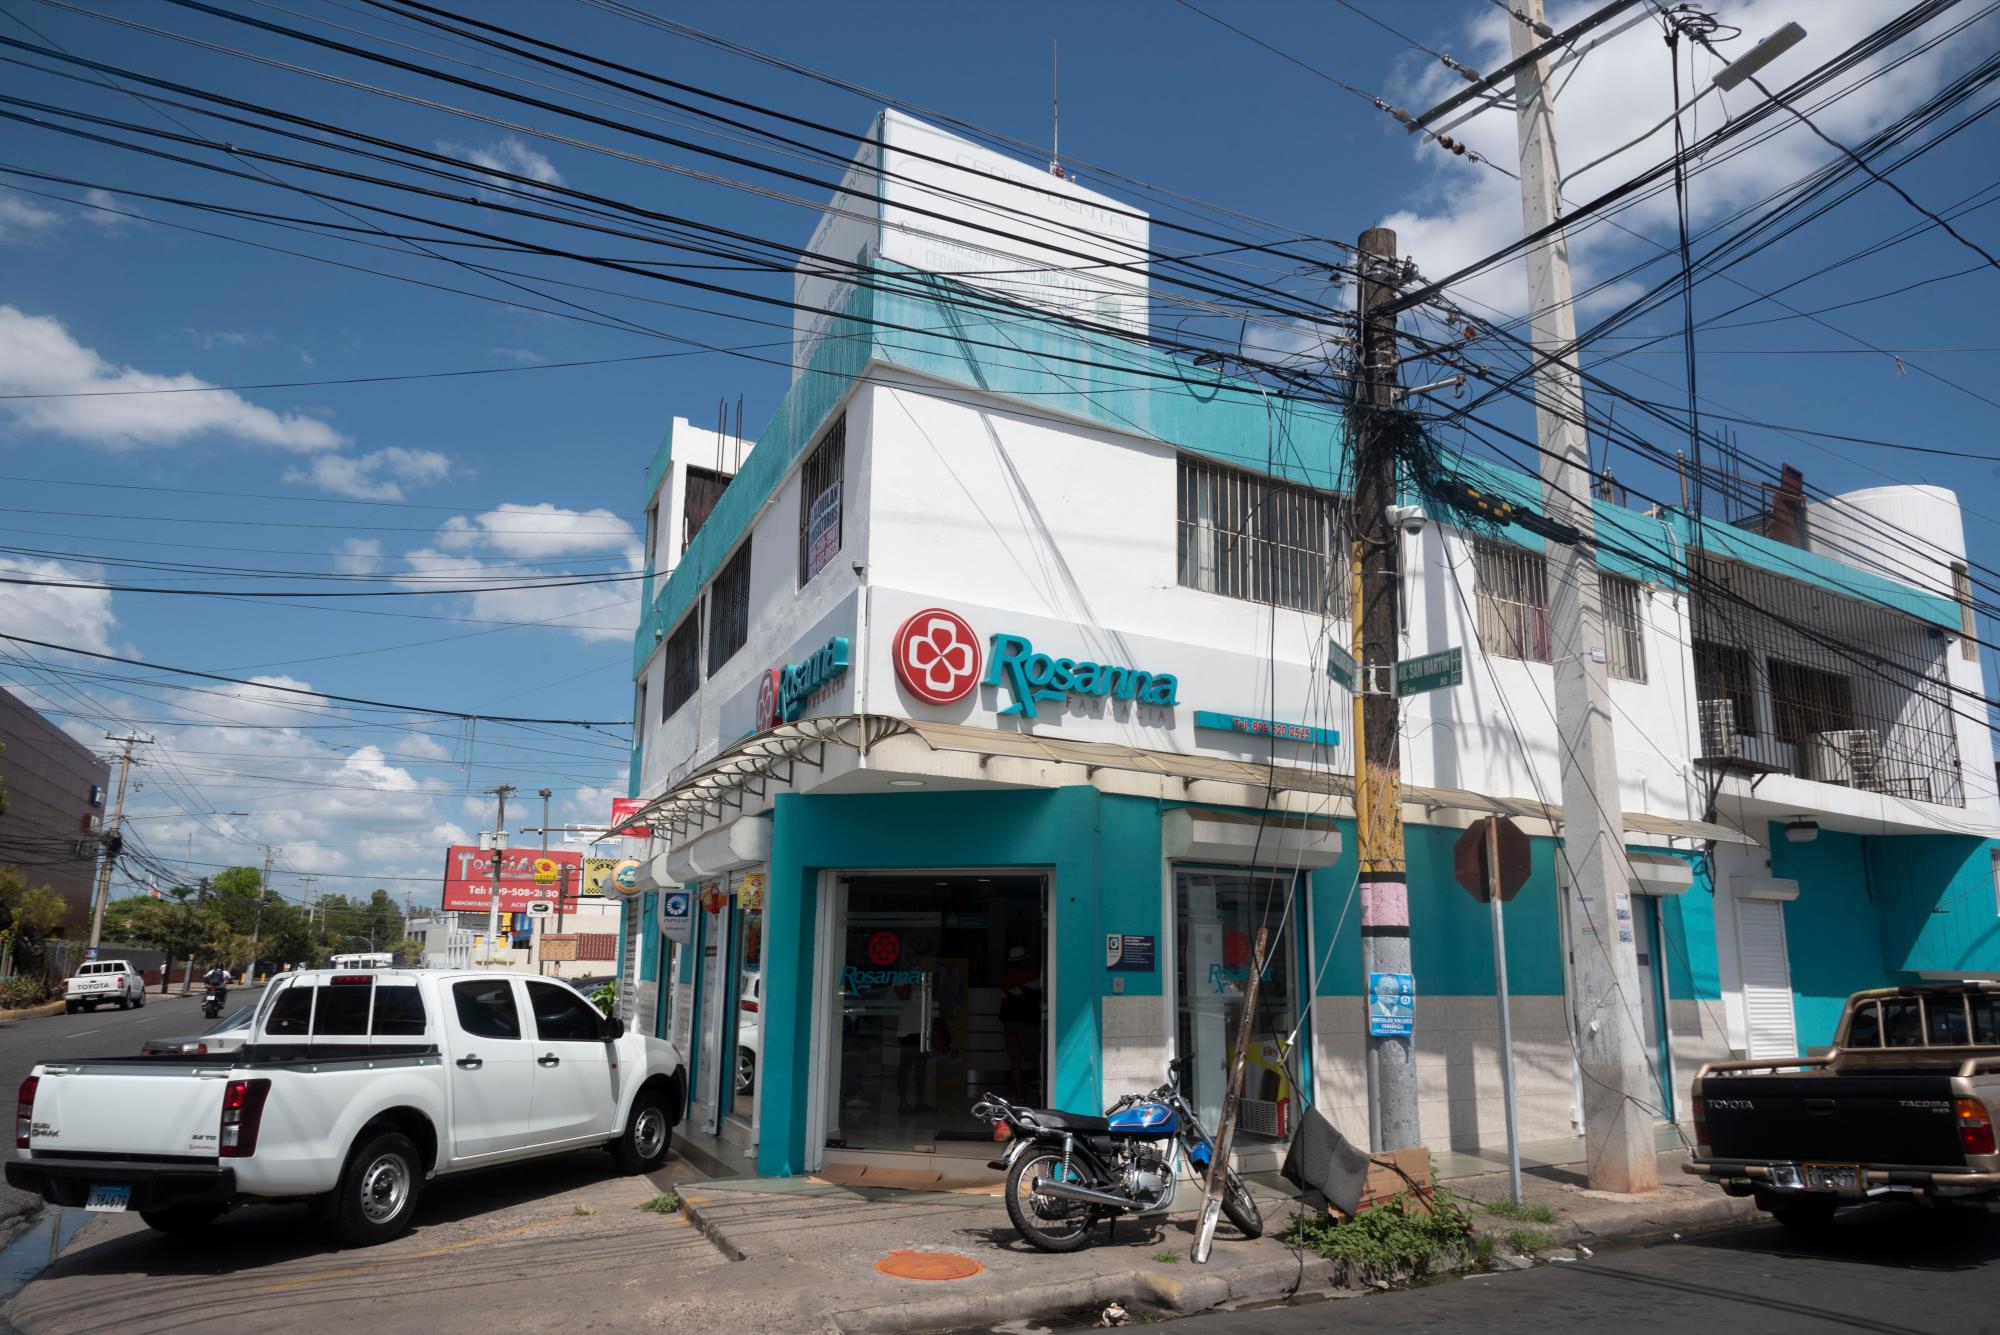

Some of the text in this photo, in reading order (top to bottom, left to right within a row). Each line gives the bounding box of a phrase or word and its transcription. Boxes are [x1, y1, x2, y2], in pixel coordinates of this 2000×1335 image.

[978, 633, 1180, 719] Rosanna
[1409, 661, 1423, 680] SAN
[1424, 655, 1450, 676] MARTIN
[1065, 696, 1166, 722] FARMACIA
[1252, 721, 1268, 734] 809
[468, 885, 486, 895] Tel:
[1706, 1099, 1754, 1110] TOYOTA
